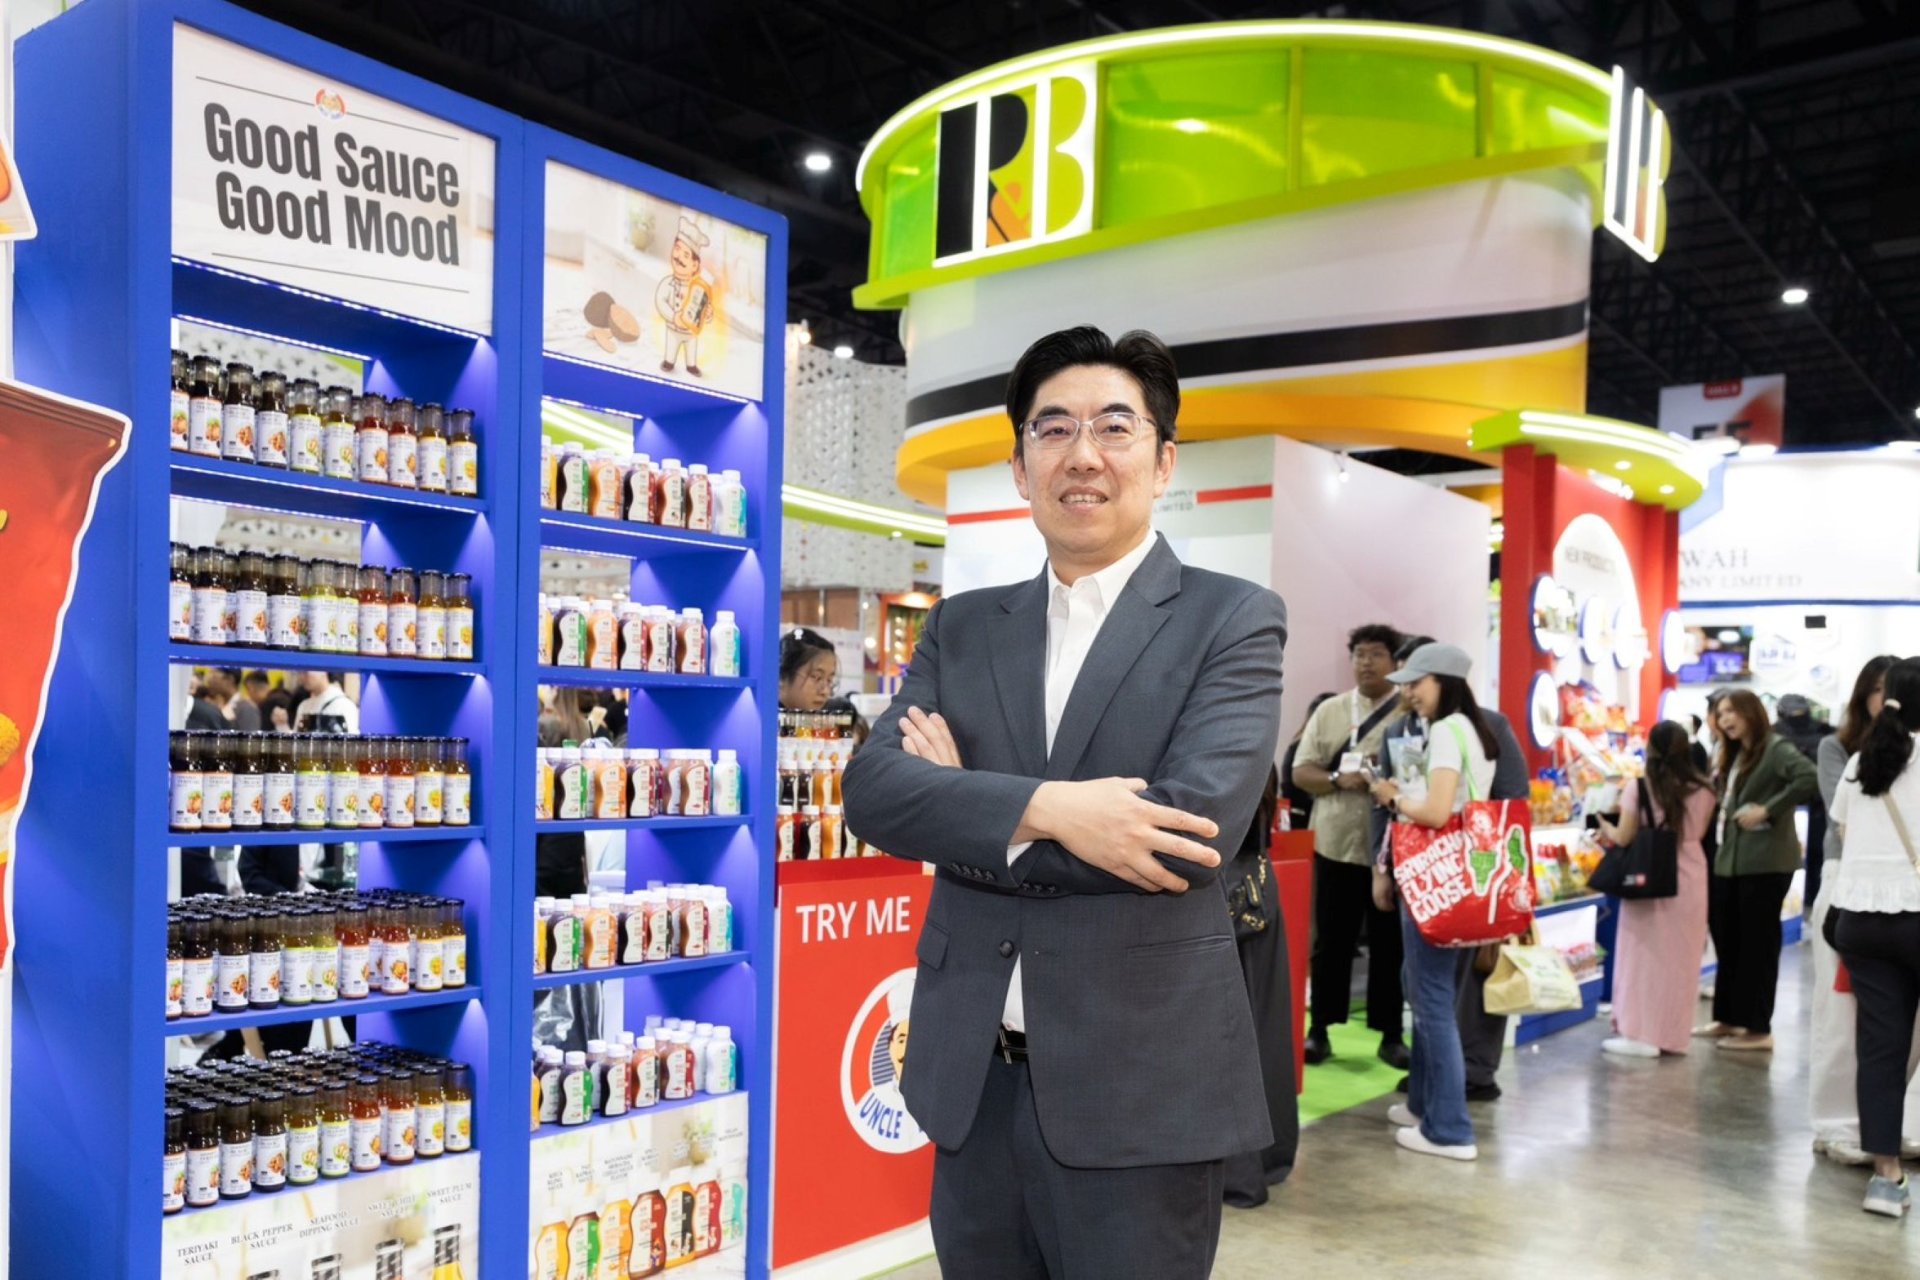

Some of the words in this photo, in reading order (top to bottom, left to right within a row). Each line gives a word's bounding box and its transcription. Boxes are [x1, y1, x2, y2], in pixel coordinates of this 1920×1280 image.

[204, 102, 321, 181] Good
[334, 132, 460, 208] Sauce
[215, 171, 331, 245] Good
[345, 195, 460, 266] Mood
[1720, 574, 1802, 588] LIMITED
[1402, 853, 1464, 905] FLYING
[1411, 874, 1473, 924] GOOSE
[796, 902, 857, 943] TRY
[866, 896, 911, 936] ME
[860, 1093, 903, 1139] UNCLE
[299, 1224, 332, 1239] DIPPING
[334, 1217, 360, 1231] SAUCE
[310, 1210, 348, 1226] SEAFOOD
[231, 1230, 260, 1245] BLACK
[262, 1223, 294, 1237] PEPPER
[250, 1237, 278, 1250] SAUCE
[177, 1240, 219, 1258] TERIYAKI
[184, 1252, 213, 1266] SAUCE
